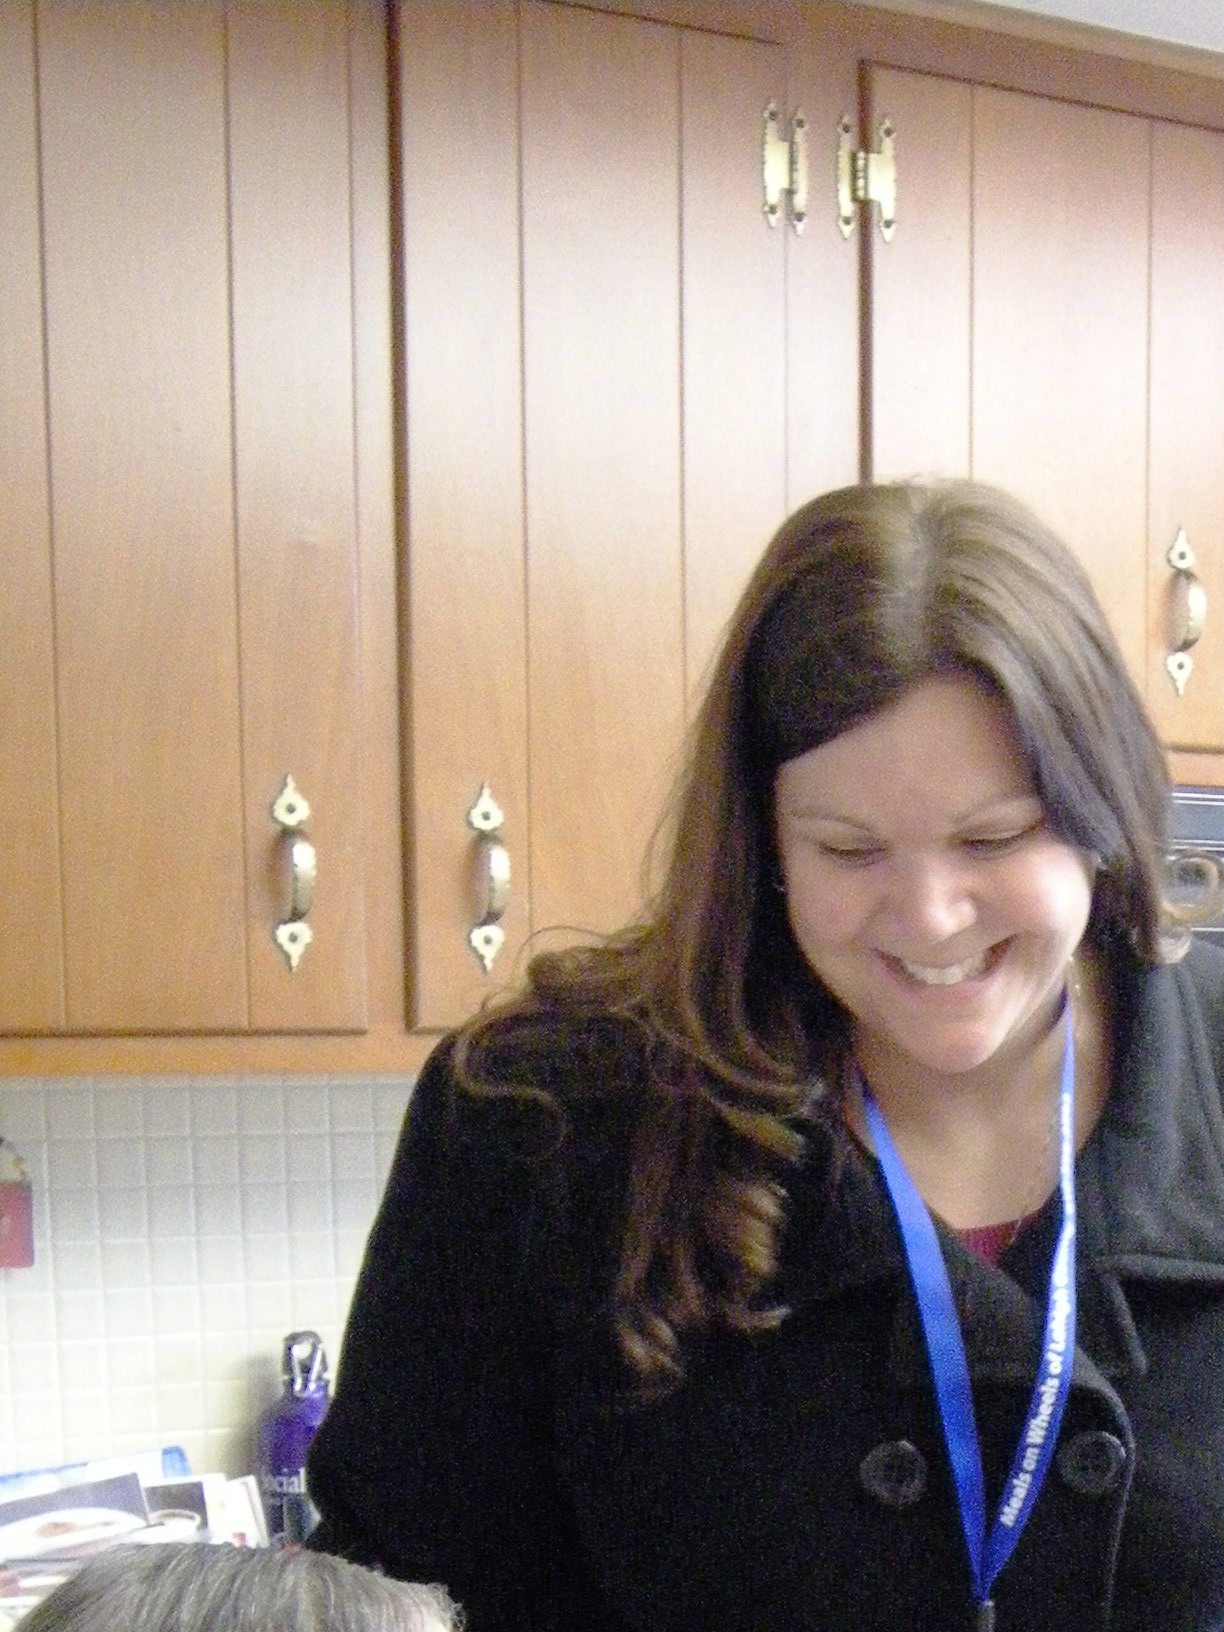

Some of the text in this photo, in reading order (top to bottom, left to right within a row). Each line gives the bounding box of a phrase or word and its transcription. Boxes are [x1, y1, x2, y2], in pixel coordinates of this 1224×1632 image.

[1047, 1351, 1063, 1375] of
[1026, 1377, 1060, 1446] Wheels
[1022, 1447, 1041, 1471] on
[1000, 1472, 1032, 1527] Meals
